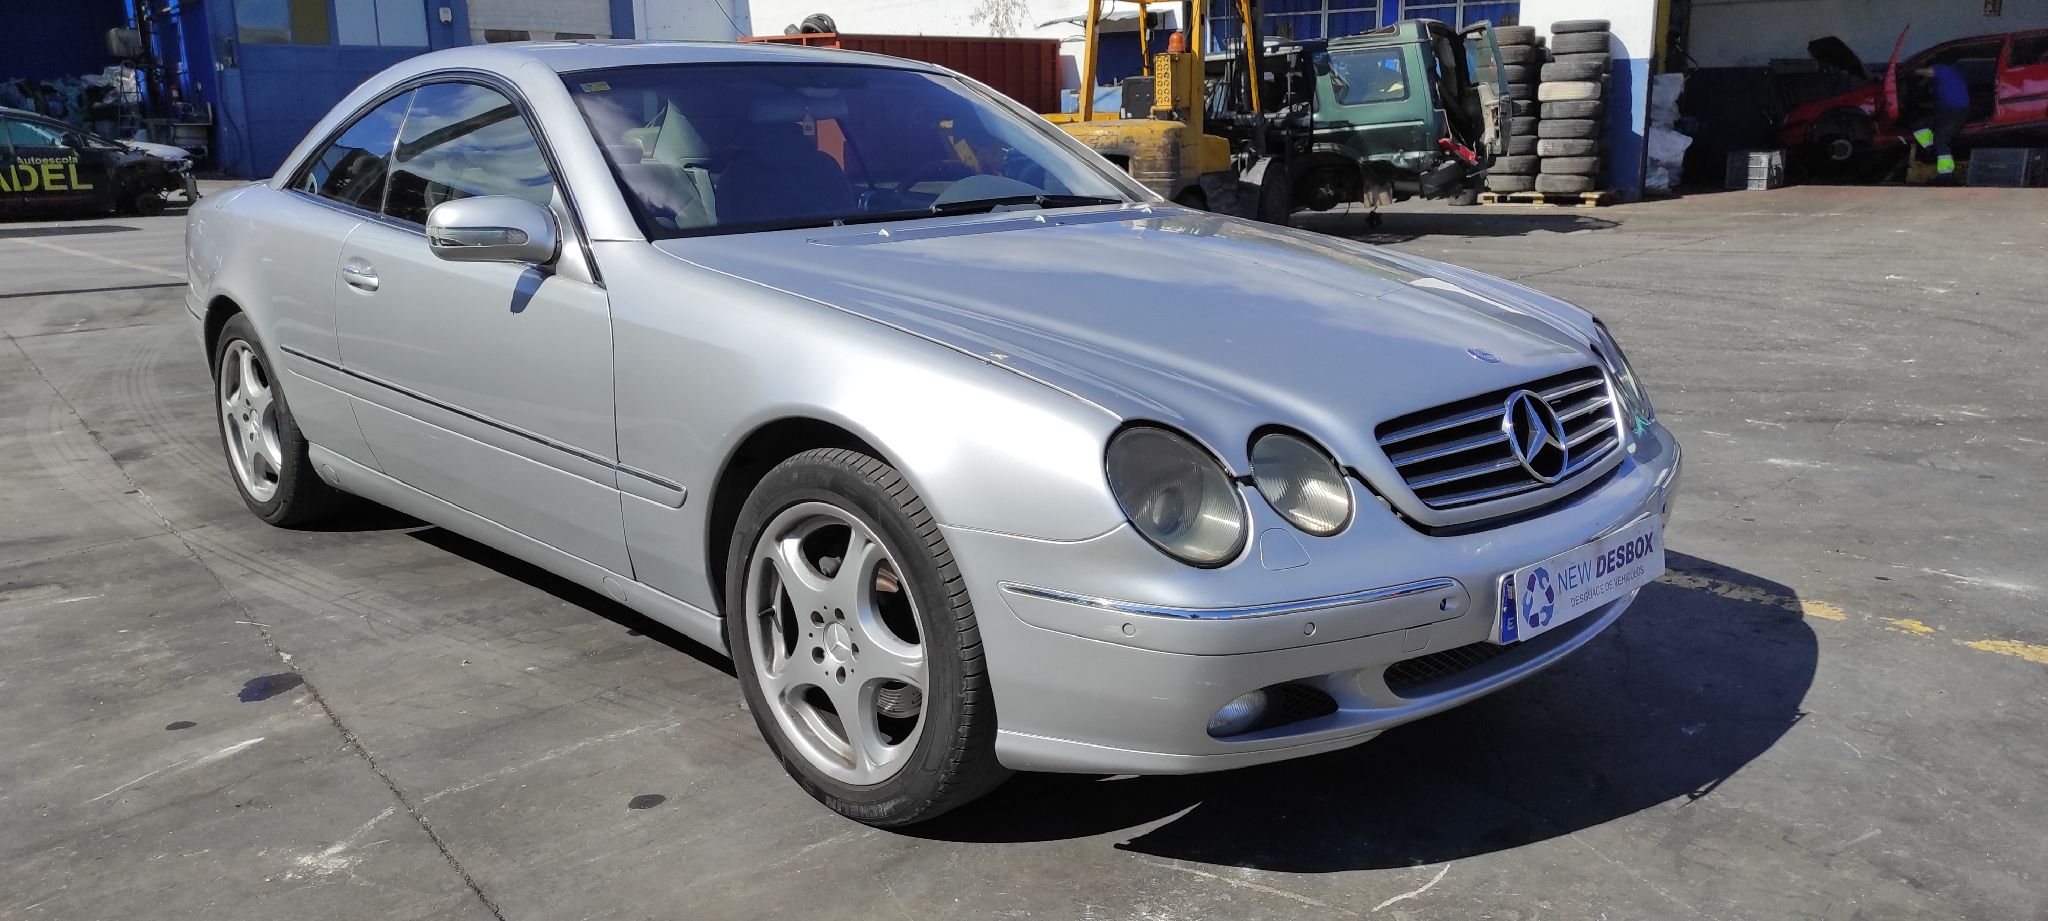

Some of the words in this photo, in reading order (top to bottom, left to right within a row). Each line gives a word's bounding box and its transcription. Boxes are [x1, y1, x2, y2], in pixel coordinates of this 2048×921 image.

[16, 156, 79, 165] Autoescola
[1557, 559, 1592, 595] NEW
[1595, 531, 1654, 579] DESBOX
[1570, 584, 1605, 608] DESGUACE
[1605, 580, 1614, 592] DE
[1507, 616, 1515, 631] E
